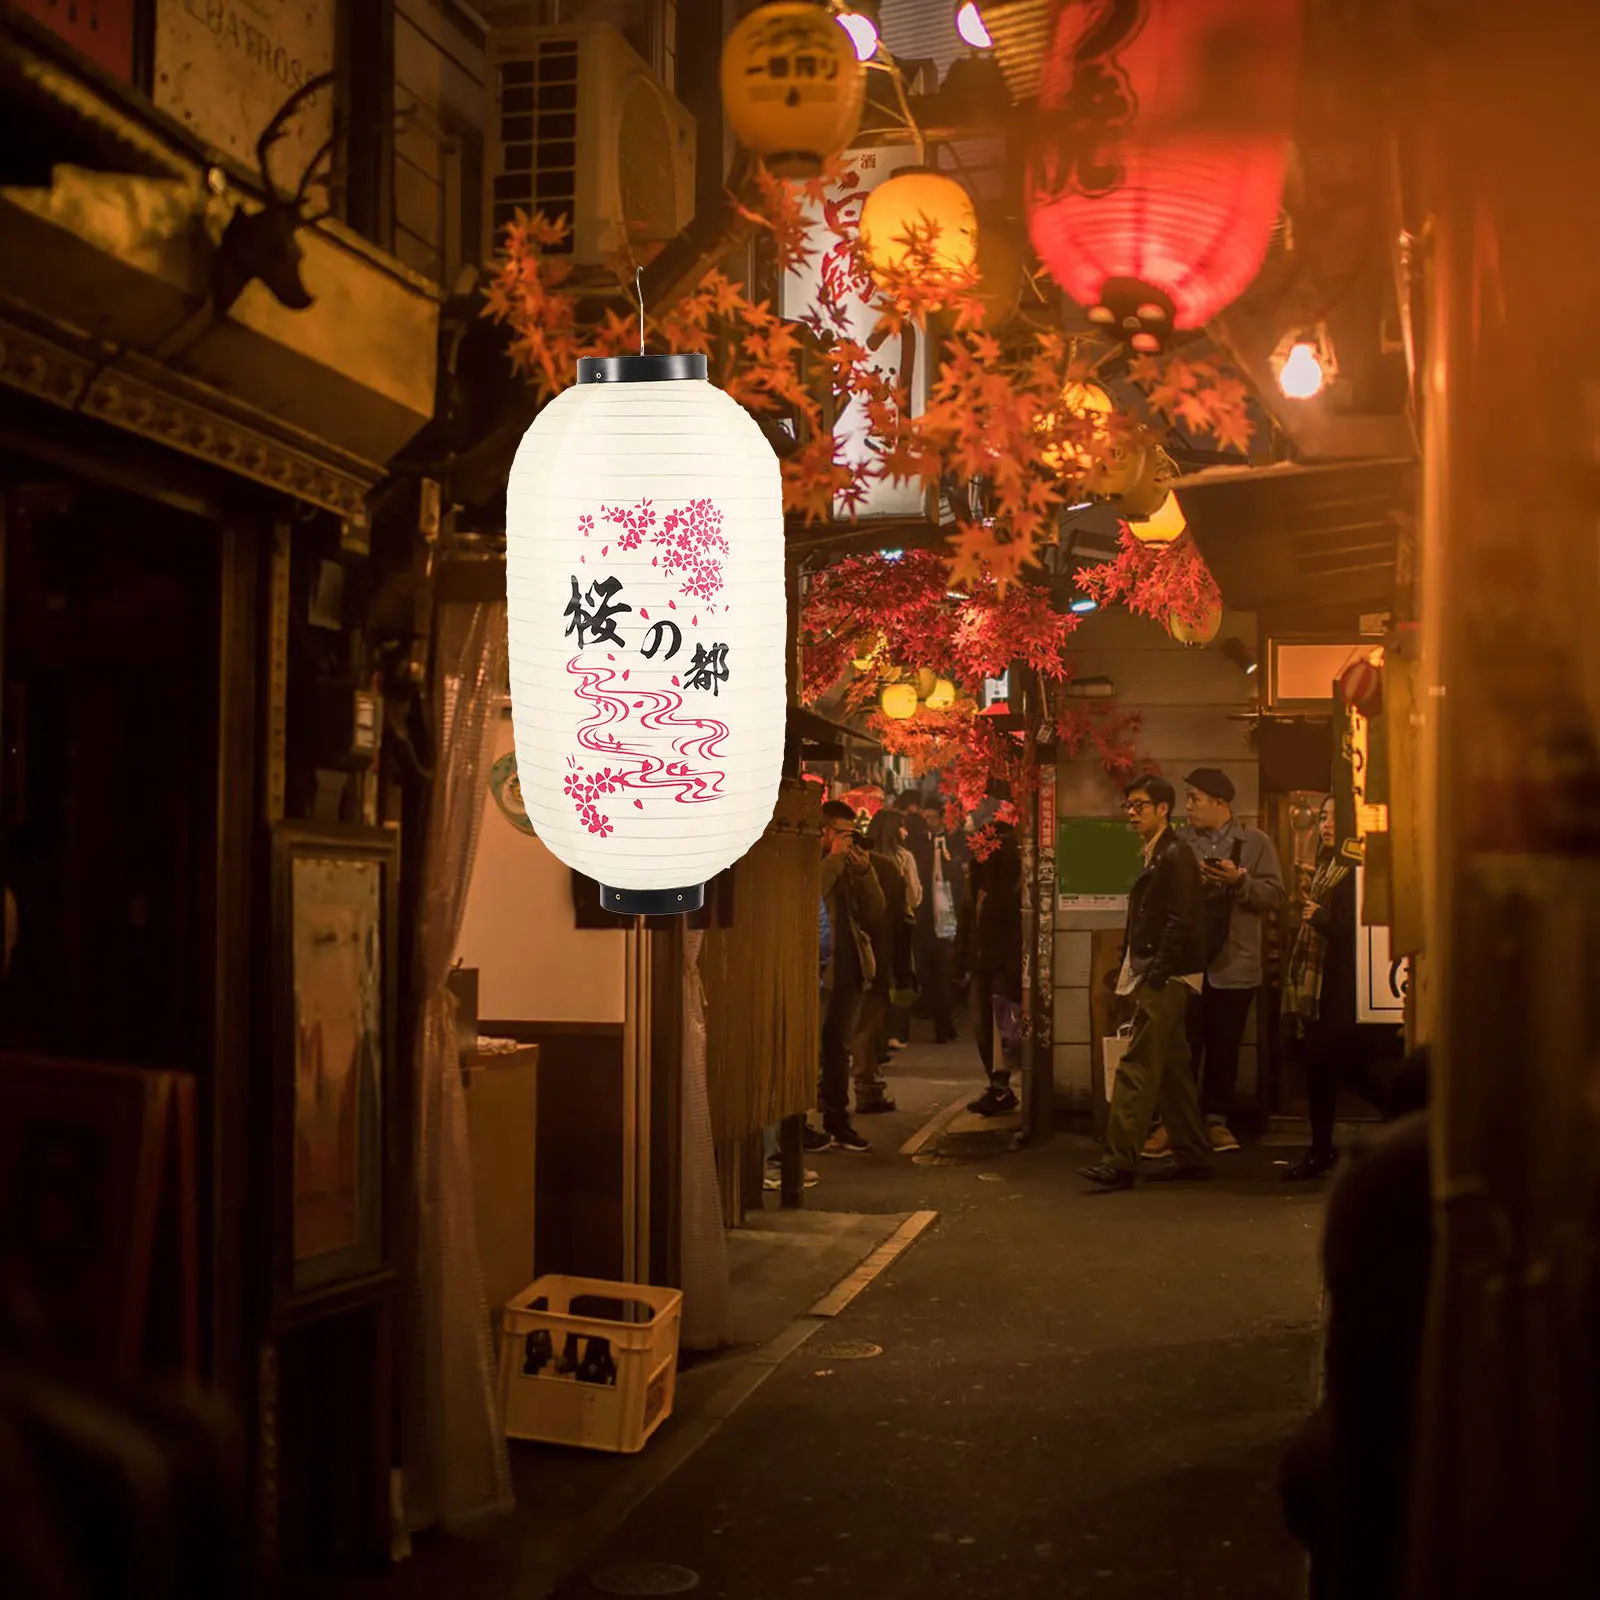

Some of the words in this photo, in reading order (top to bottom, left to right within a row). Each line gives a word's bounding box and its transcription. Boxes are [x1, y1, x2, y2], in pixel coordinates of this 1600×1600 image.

[860, 154, 877, 169] 酒
[563, 574, 730, 697] 桜の都
